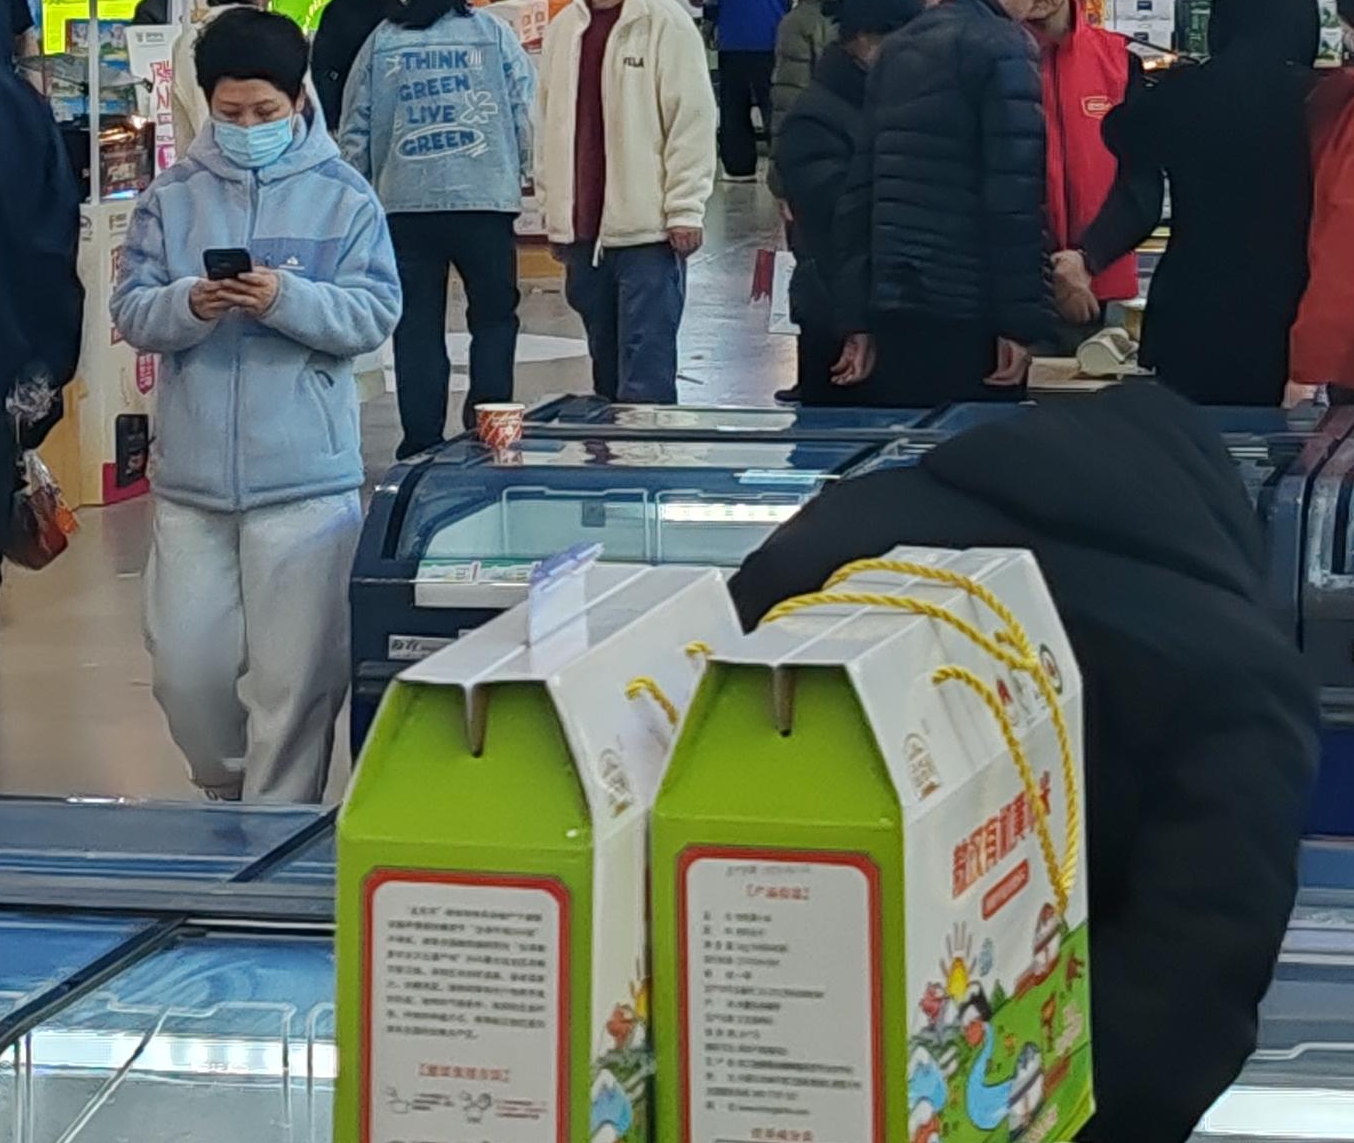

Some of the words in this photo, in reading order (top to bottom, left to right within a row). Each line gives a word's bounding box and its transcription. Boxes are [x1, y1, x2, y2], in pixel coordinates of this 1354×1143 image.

[401, 51, 470, 70] THINK
[398, 74, 472, 102] GREEN
[407, 104, 457, 124] LIVE
[401, 129, 476, 156] GREEN
